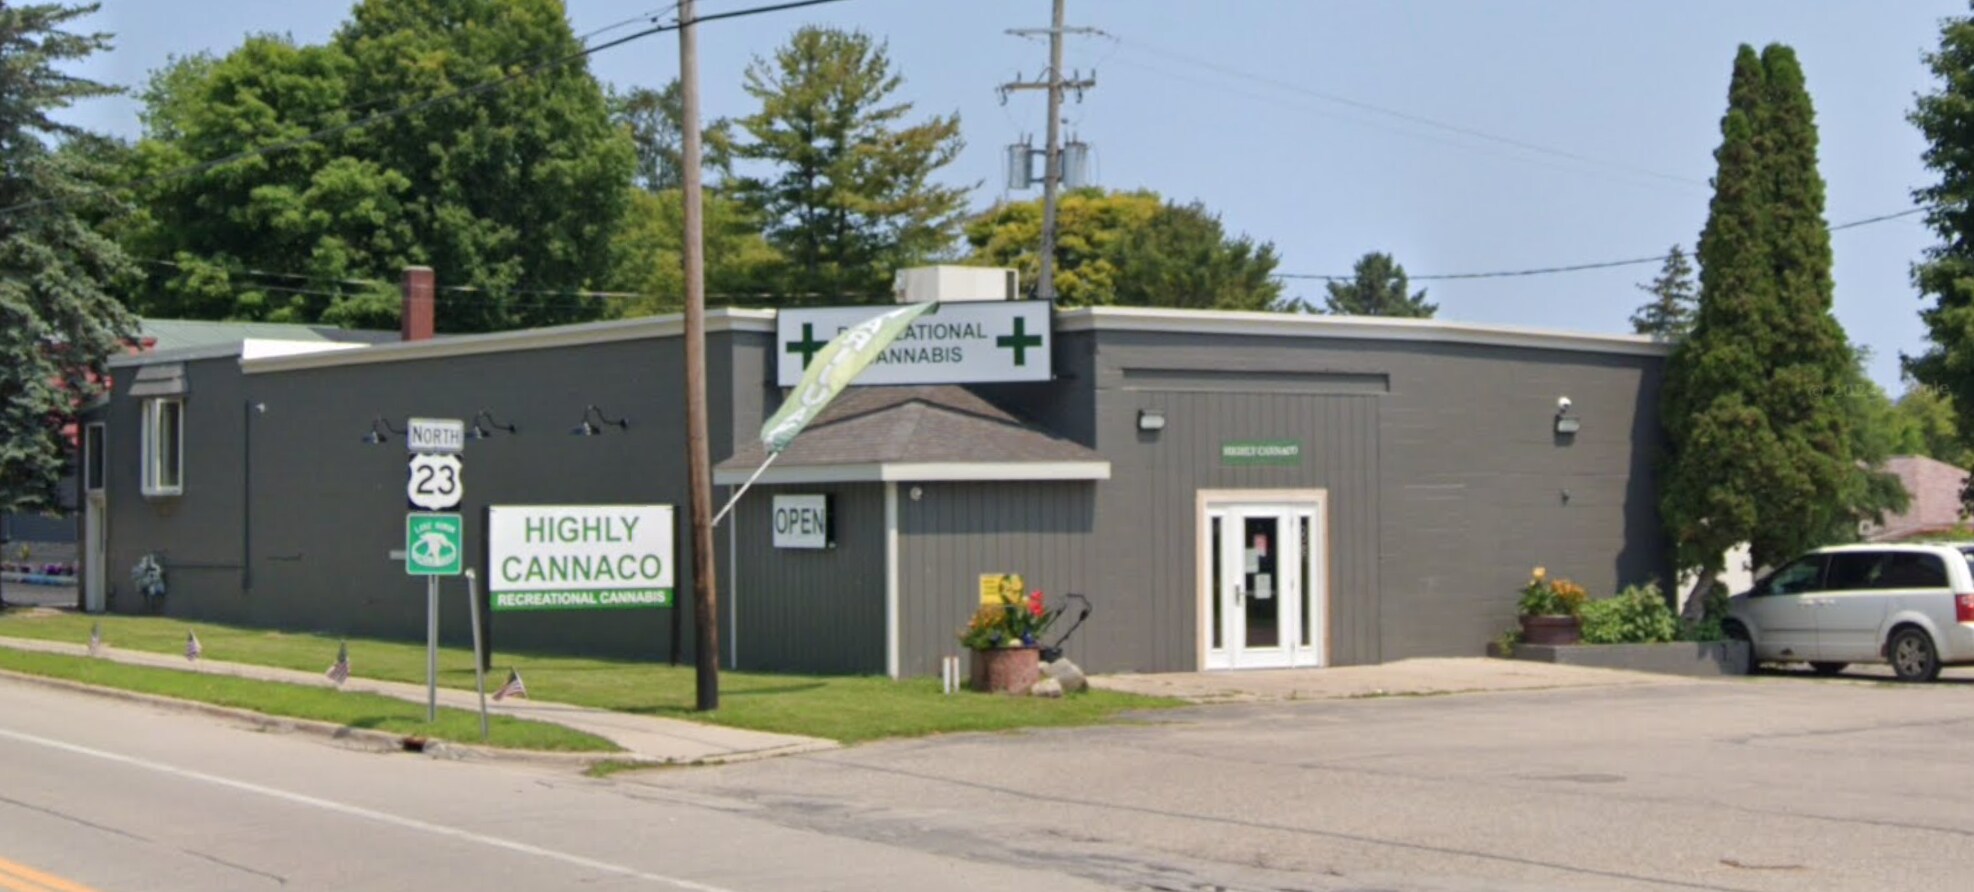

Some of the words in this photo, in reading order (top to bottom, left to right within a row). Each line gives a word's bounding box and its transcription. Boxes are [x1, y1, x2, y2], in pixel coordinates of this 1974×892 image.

[837, 322, 987, 341] ATIONAL
[868, 346, 963, 364] ANNABIS
[412, 425, 460, 445] NORTH
[416, 464, 456, 495] 23
[525, 516, 639, 543] HIGHLY
[774, 508, 824, 535] OPEN
[501, 554, 662, 582] CANNACO
[498, 593, 597, 606] RECREATIONAL
[600, 590, 666, 604] CANNABIS
